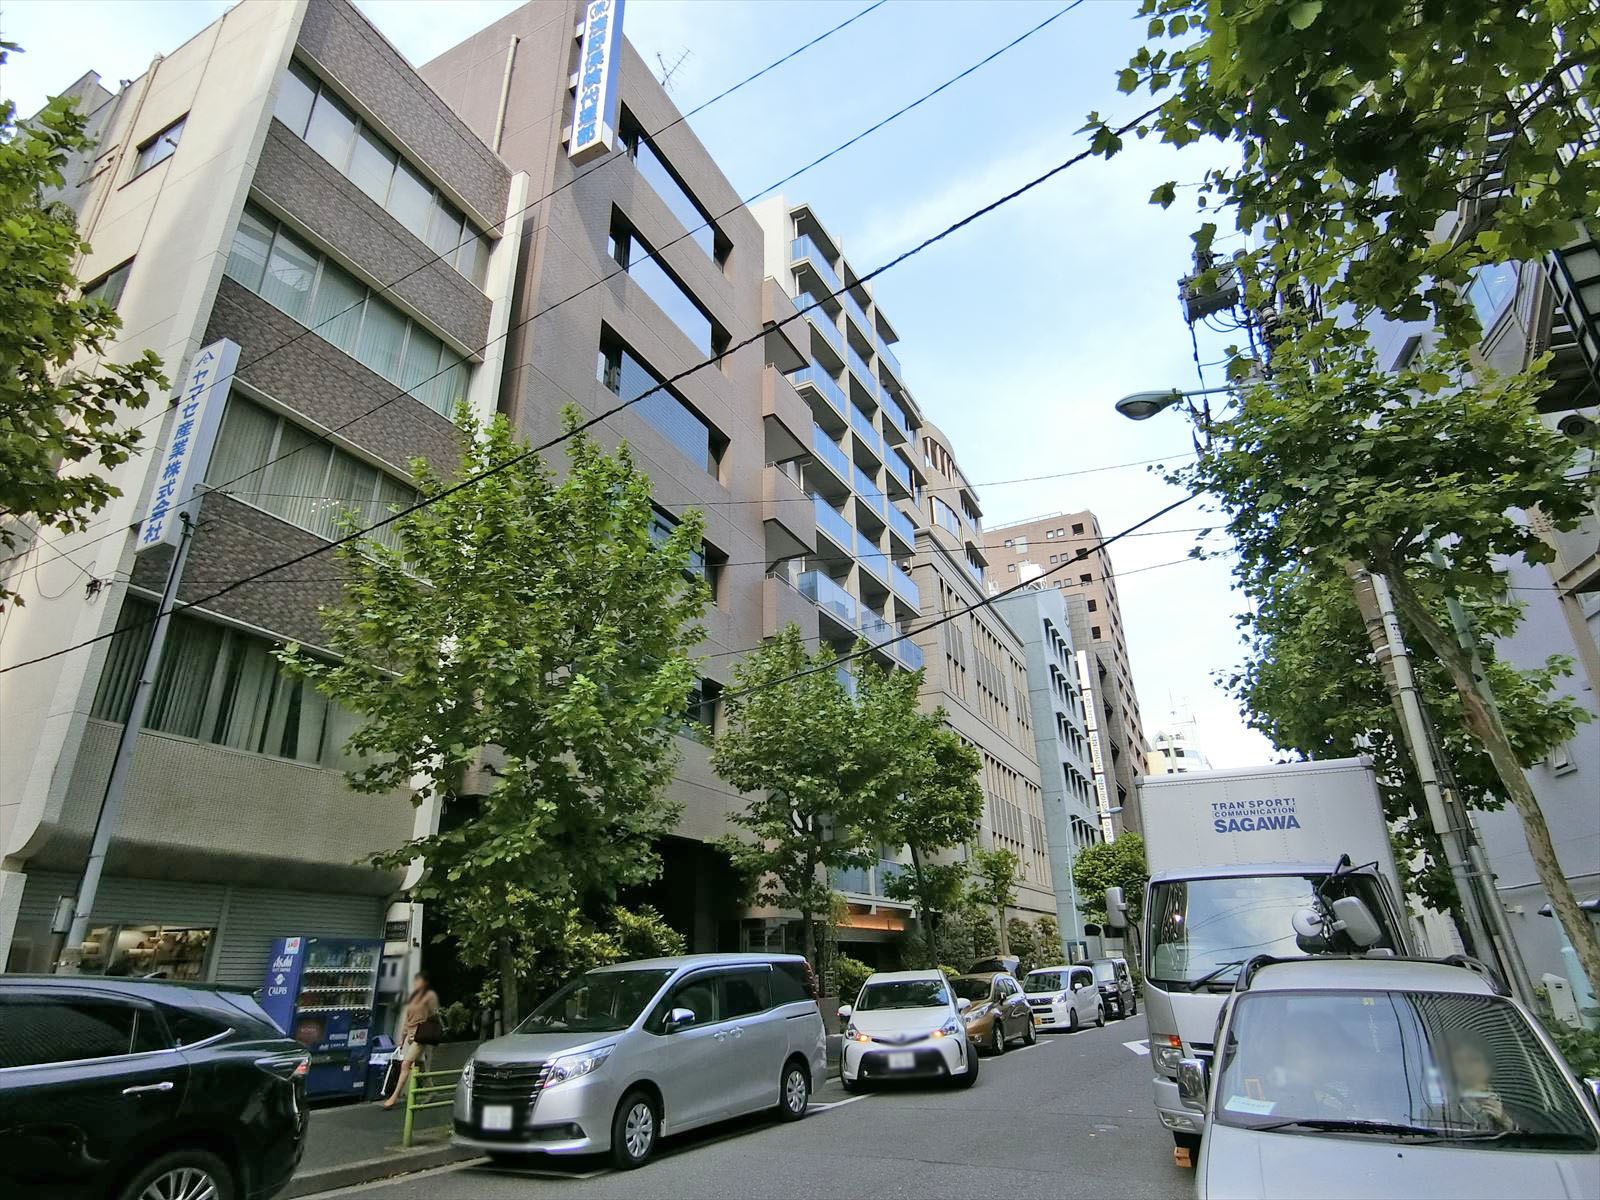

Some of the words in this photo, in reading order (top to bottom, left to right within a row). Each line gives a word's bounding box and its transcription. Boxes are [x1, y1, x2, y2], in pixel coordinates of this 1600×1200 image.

[143, 370, 208, 543] ヤマセ産業株式会社
[1214, 807, 1296, 818] COMMUNICATION
[1214, 815, 1301, 833] SAGAWA
[268, 986, 288, 997] CALPIS
